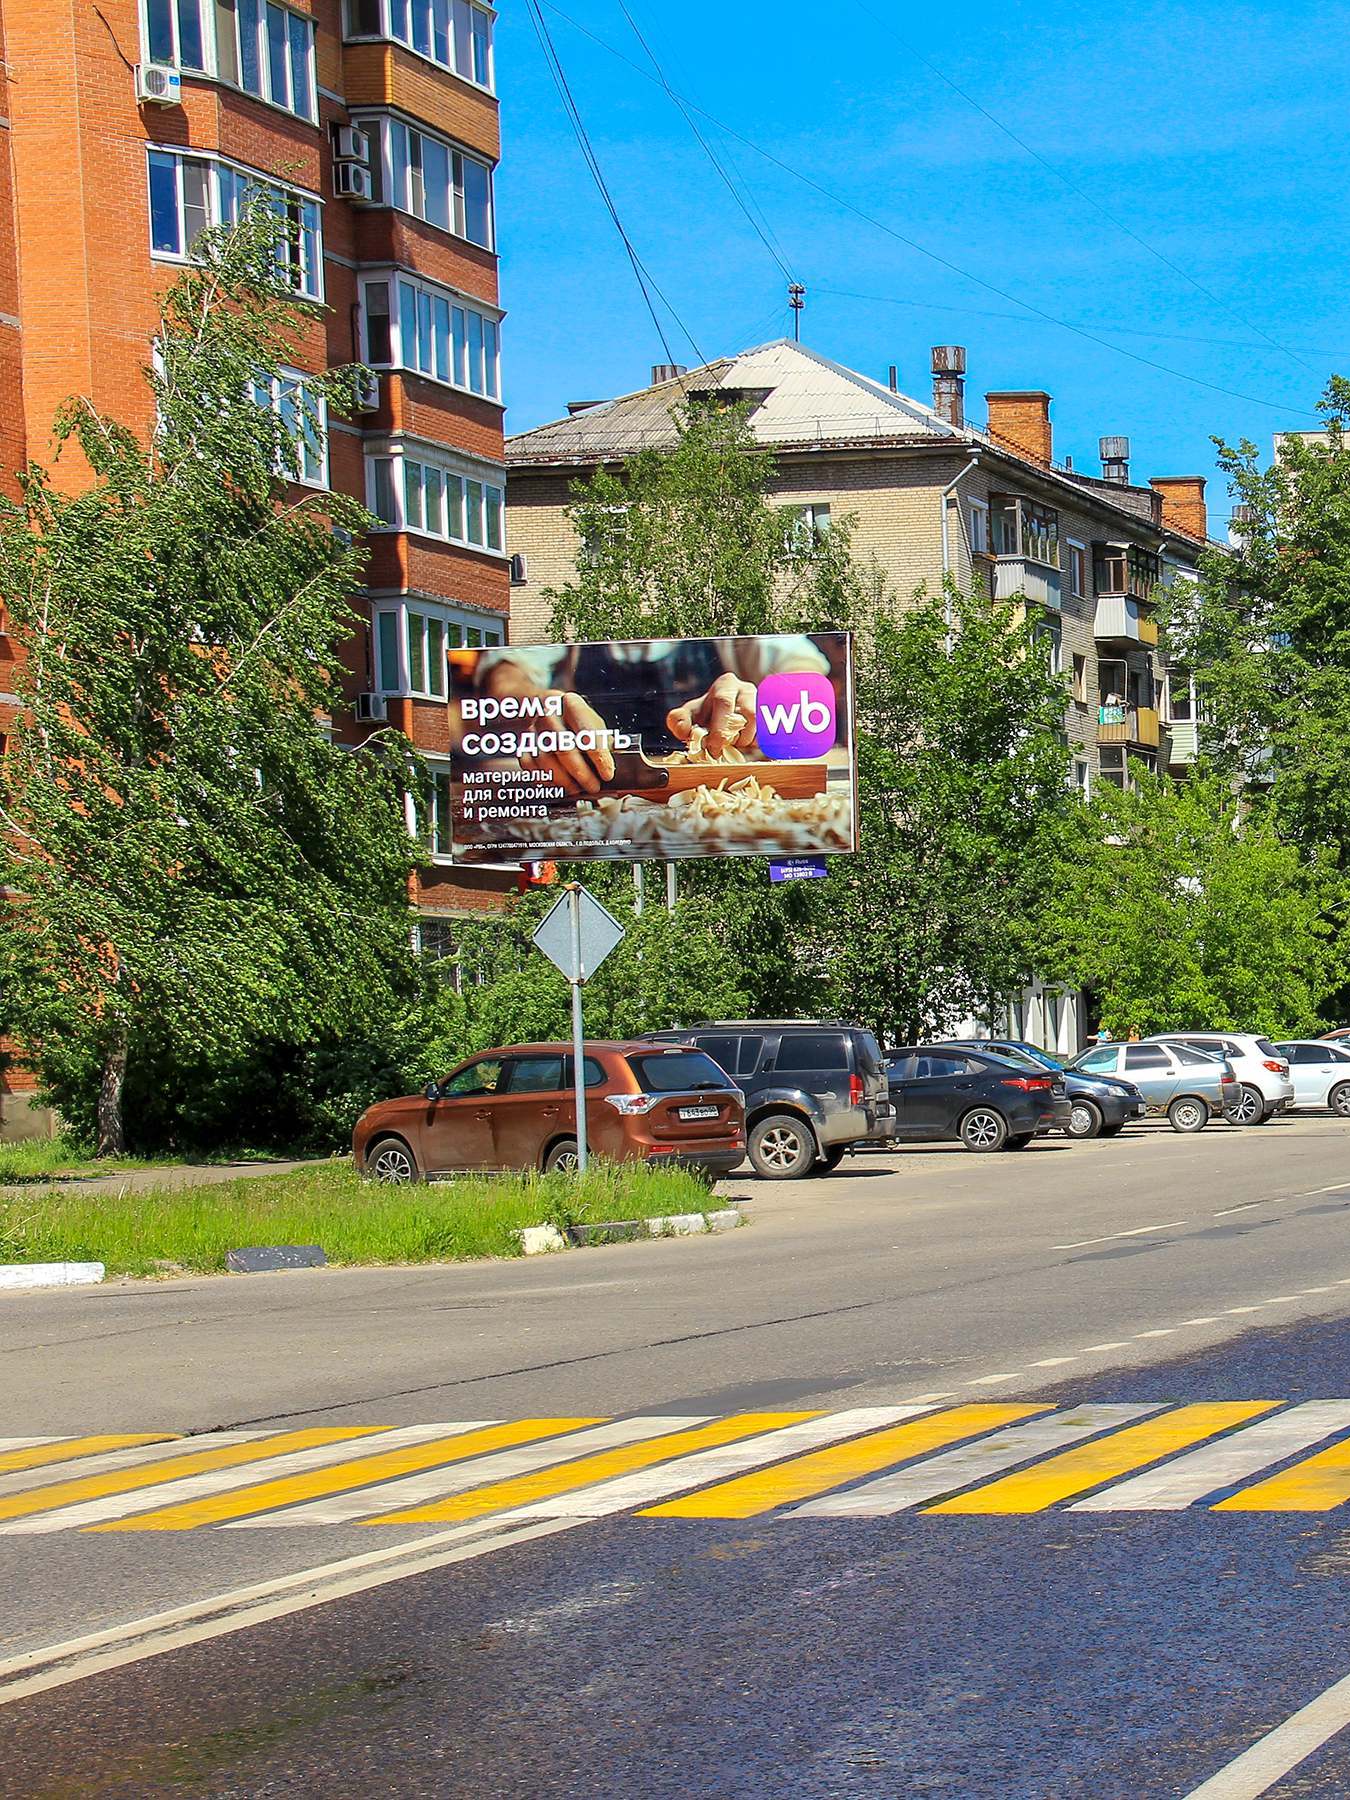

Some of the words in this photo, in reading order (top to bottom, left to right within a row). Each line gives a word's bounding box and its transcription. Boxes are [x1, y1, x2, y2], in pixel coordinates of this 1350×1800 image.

[461, 695, 563, 726] время
[760, 690, 831, 735] wb
[461, 728, 632, 758] создавать
[462, 769, 553, 786] материалы
[462, 789, 492, 804] для
[497, 784, 564, 803] стройки
[463, 807, 473, 819] и
[478, 804, 548, 821] ремонта
